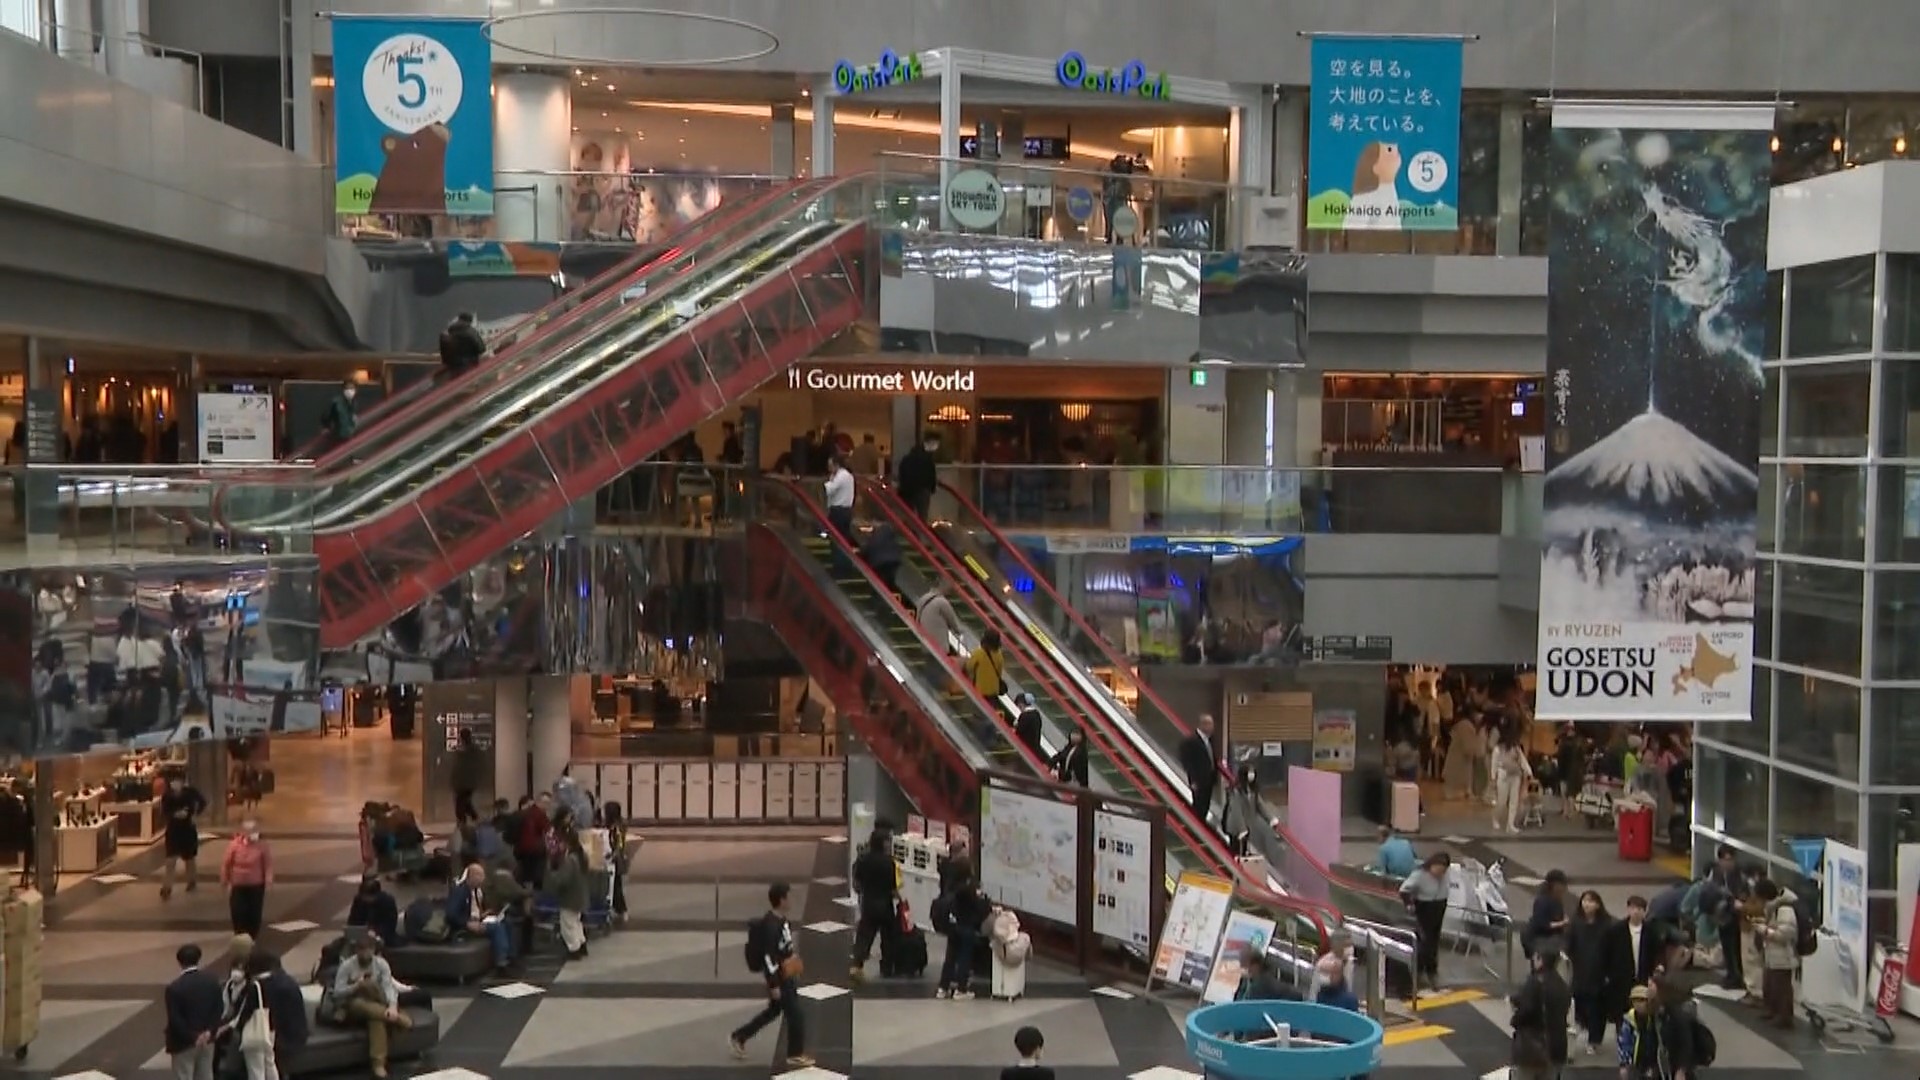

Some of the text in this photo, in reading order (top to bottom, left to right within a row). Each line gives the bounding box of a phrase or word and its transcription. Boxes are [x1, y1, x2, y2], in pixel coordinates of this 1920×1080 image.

[1330, 59, 1411, 79] 空を見る。
[396, 54, 427, 109] 5
[1329, 85, 1441, 107] 大地のことを、
[1328, 112, 1424, 133] 考えている。
[1421, 160, 1434, 183] 5
[1324, 203, 1435, 219] Hokkaido Airports
[807, 368, 975, 391] Gourmet World
[1564, 624, 1622, 638] RYUZEN
[1547, 646, 1655, 668] GOSETSU
[1547, 669, 1655, 698] UDON
